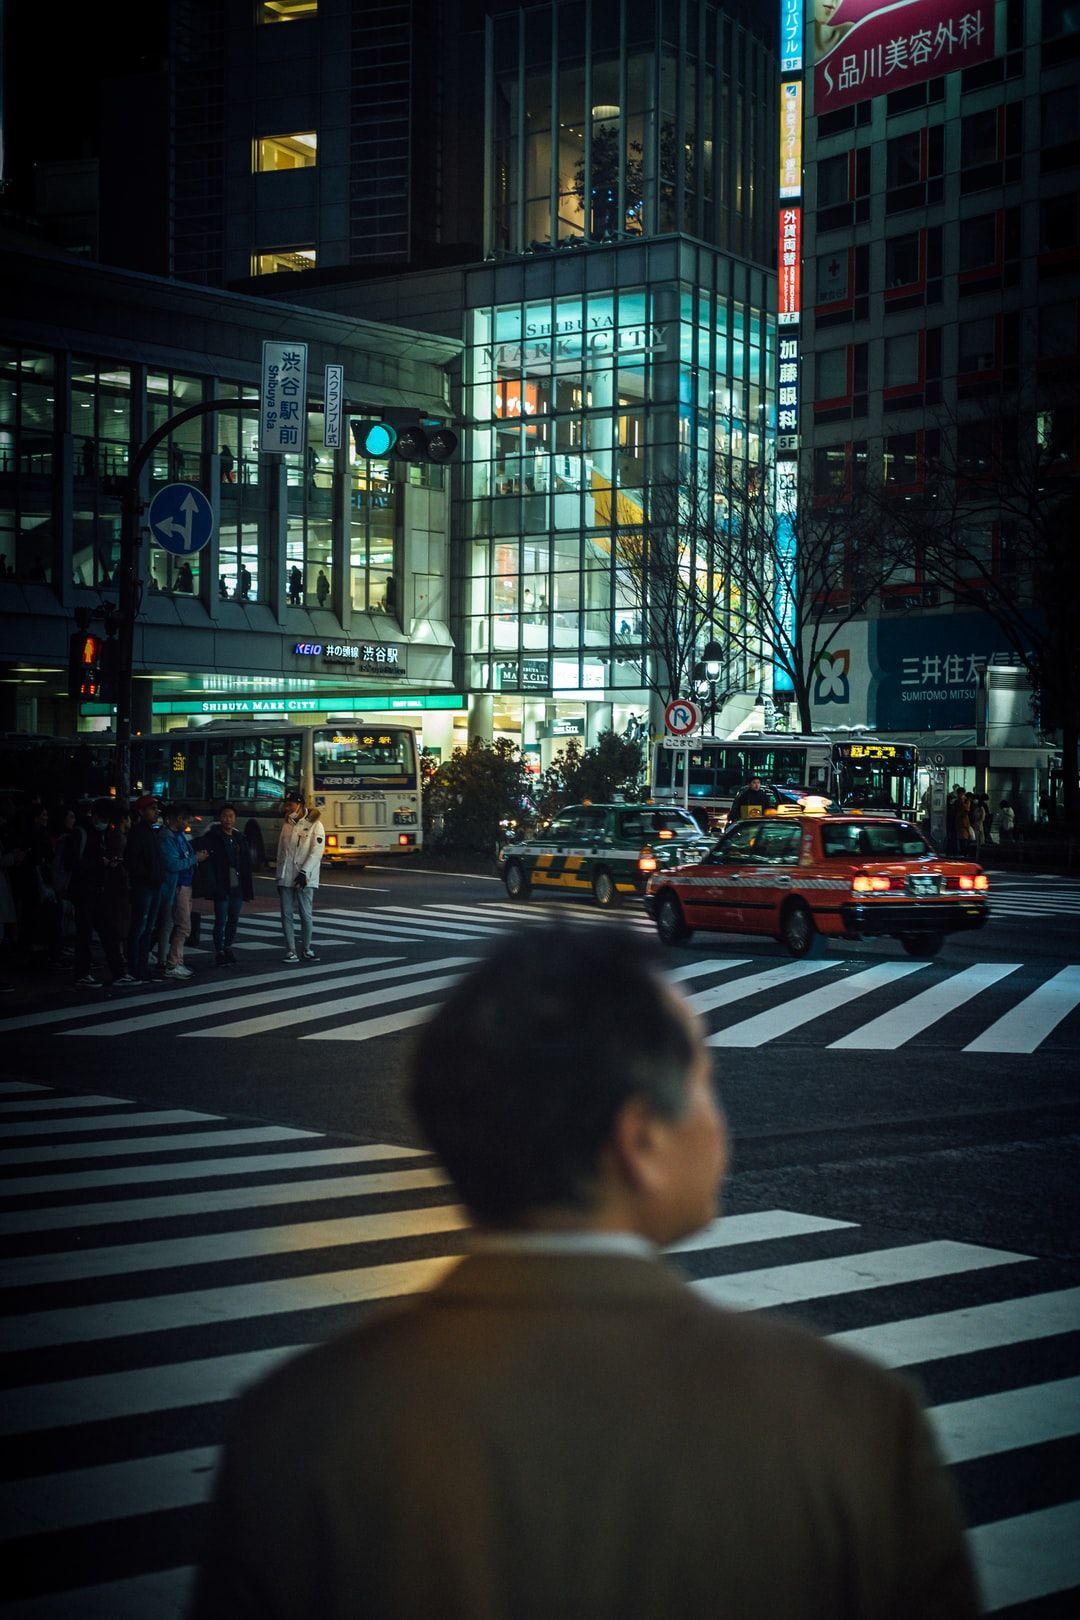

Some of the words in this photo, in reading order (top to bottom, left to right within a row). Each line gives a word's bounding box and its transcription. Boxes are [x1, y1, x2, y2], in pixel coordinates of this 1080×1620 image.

[838, 9, 984, 91] 品川美容外科
[786, 61, 798, 69] 9F
[526, 315, 615, 337] SHIBUYA
[783, 313, 796, 322] 7F
[482, 338, 573, 366] MARK
[590, 326, 668, 351] CITY
[266, 364, 279, 408] Shibuya
[779, 340, 798, 430] 加藤眼科
[279, 351, 301, 445] 渋谷駅前
[266, 411, 277, 433] Sta.
[780, 437, 796, 448] 5F
[295, 643, 322, 655] KEIO
[325, 645, 360, 659] 井の頭線
[362, 646, 399, 664] 渋谷駅
[503, 672, 529, 680] MAK
[901, 652, 1033, 684] 三井住友
[202, 702, 249, 711] SHIBUYA
[252, 702, 286, 710] MARK
[289, 701, 316, 709] CITY
[901, 690, 948, 701] SUMITOMO
[949, 689, 976, 700] MITSU
